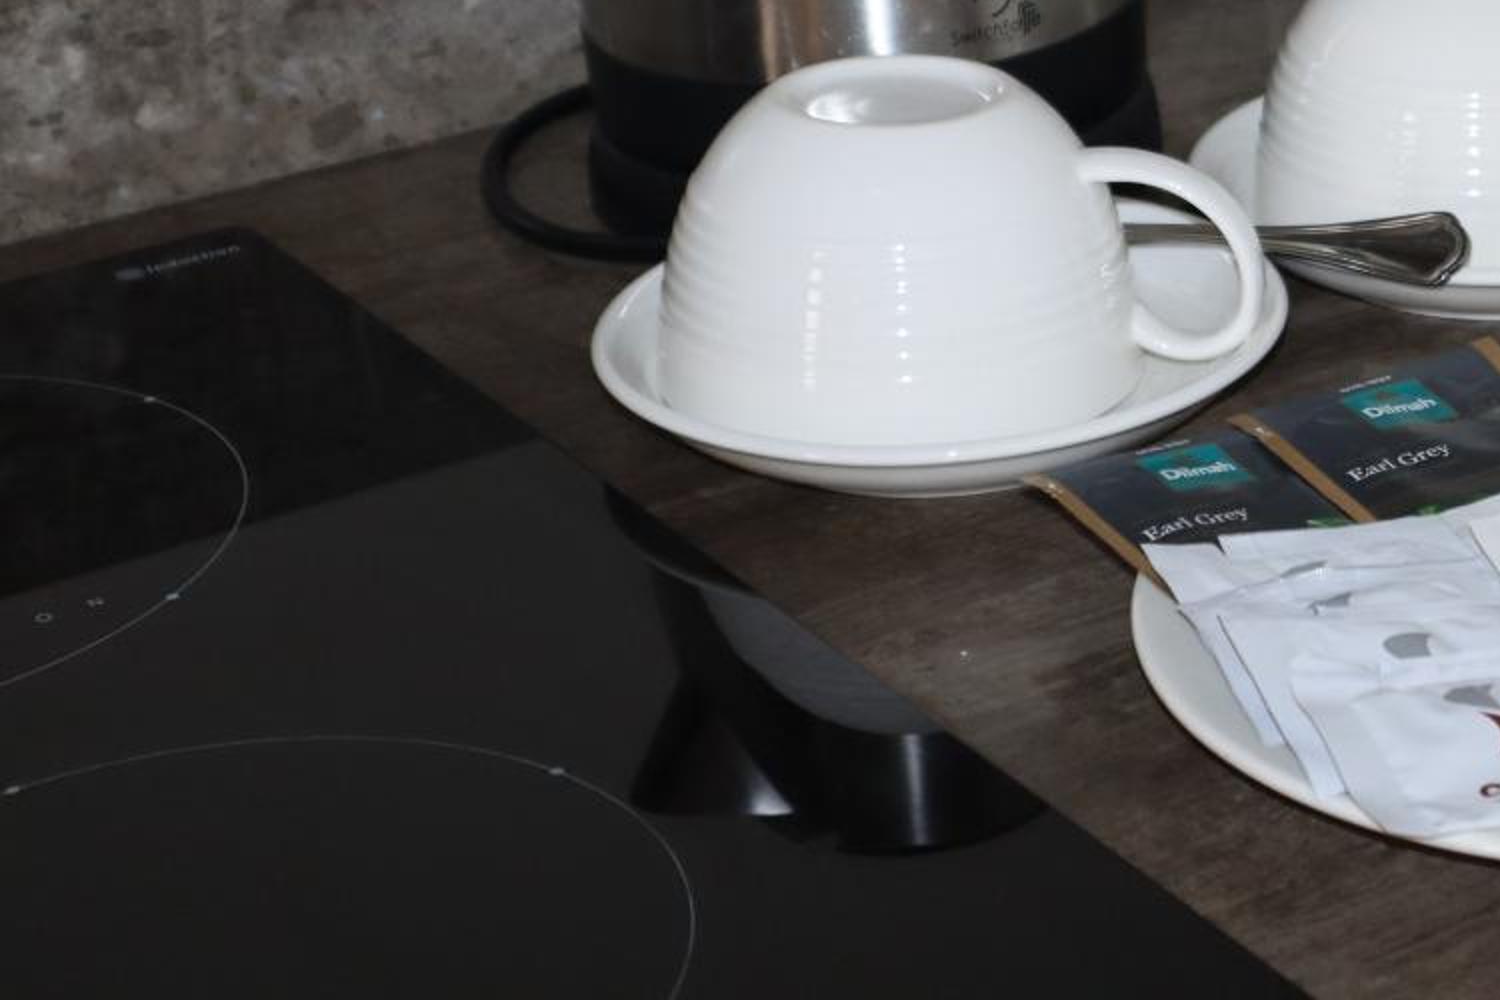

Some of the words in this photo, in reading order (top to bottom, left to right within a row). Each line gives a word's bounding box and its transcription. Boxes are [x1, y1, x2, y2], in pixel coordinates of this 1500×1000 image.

[1361, 398, 1438, 419] Dilmah
[1160, 460, 1237, 481] Dilmah
[1345, 457, 1397, 482] Earl
[1396, 443, 1451, 466] Grey
[1141, 515, 1196, 542] Earl
[1193, 507, 1249, 526] Grey
